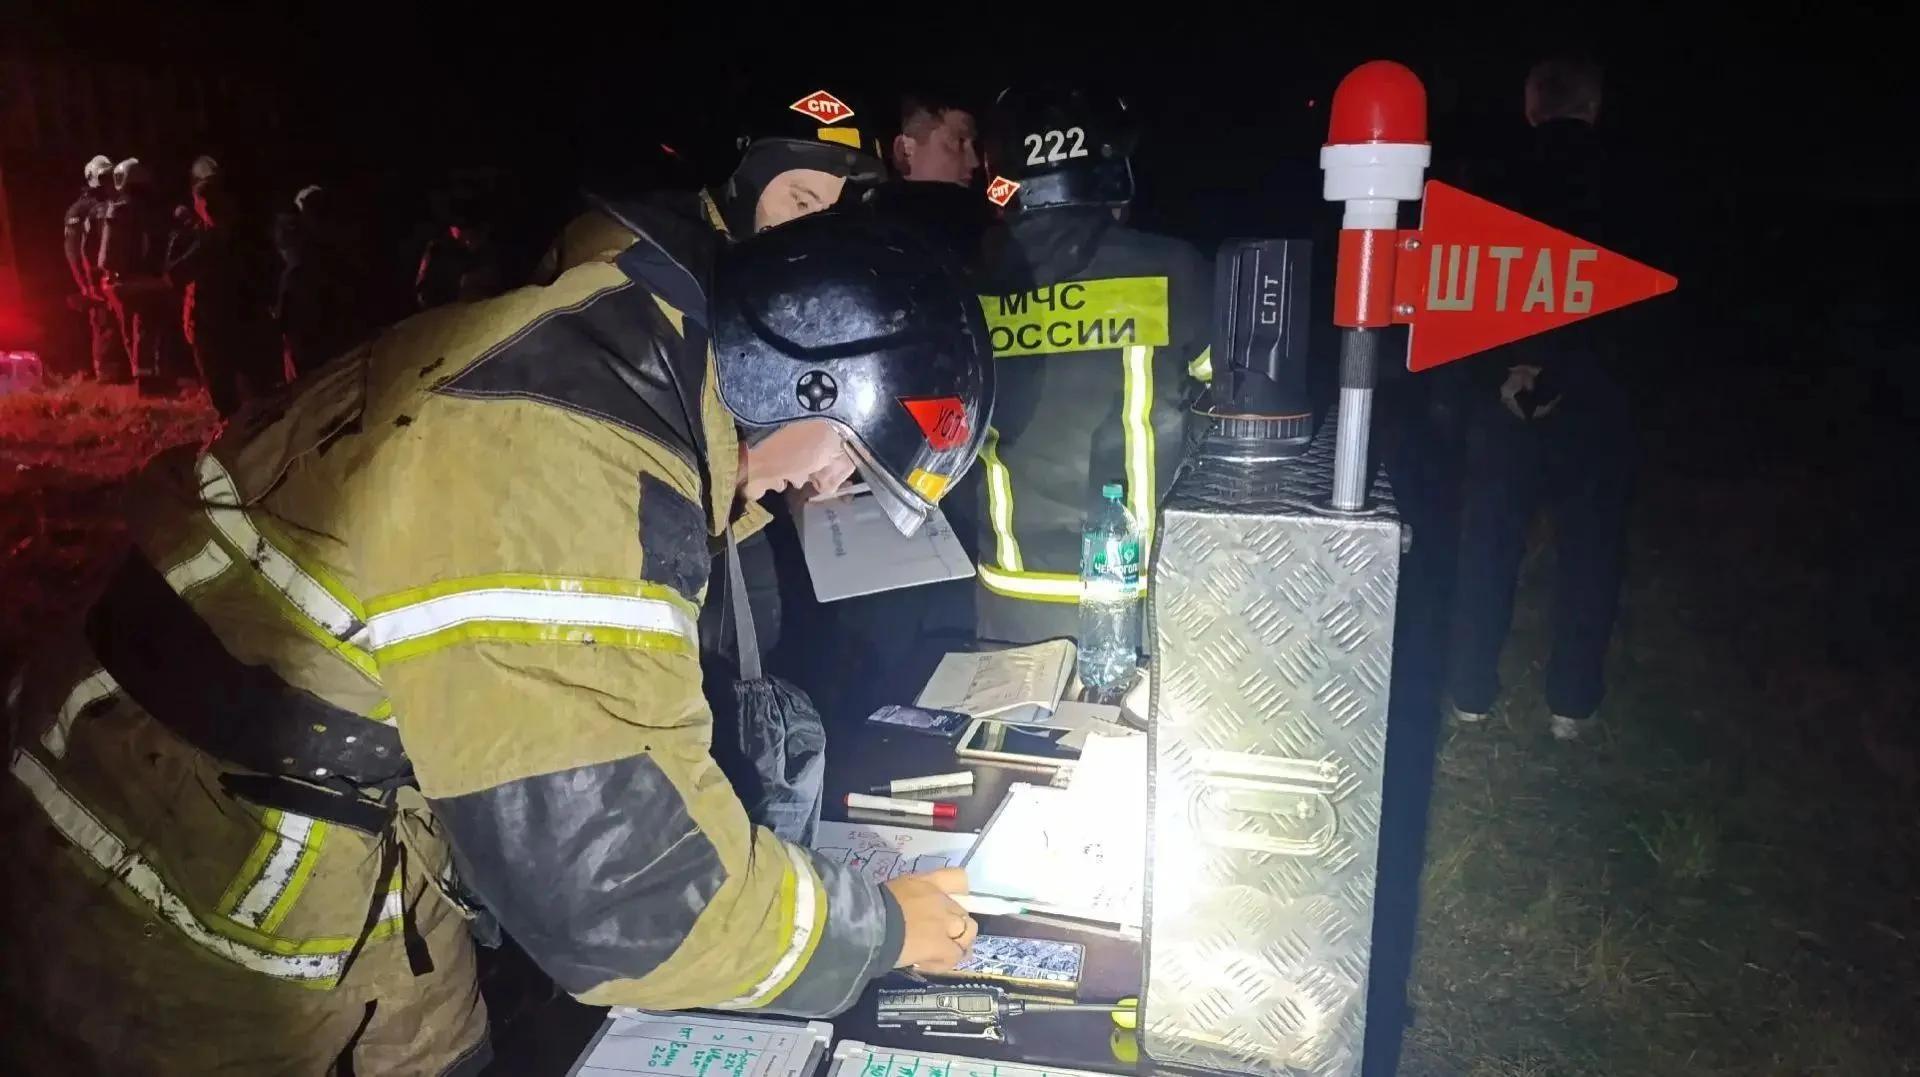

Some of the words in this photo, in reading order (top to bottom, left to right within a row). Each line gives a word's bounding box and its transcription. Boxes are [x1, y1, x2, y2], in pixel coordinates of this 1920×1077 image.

[807, 99, 841, 115] СПТ
[1024, 126, 1088, 166] 222
[991, 183, 1010, 199] СПТ
[1426, 244, 1598, 313] ШТАБ
[1000, 284, 1086, 316] МЧС
[1261, 275, 1279, 325] СПТ
[989, 318, 1136, 352] ОССИИ
